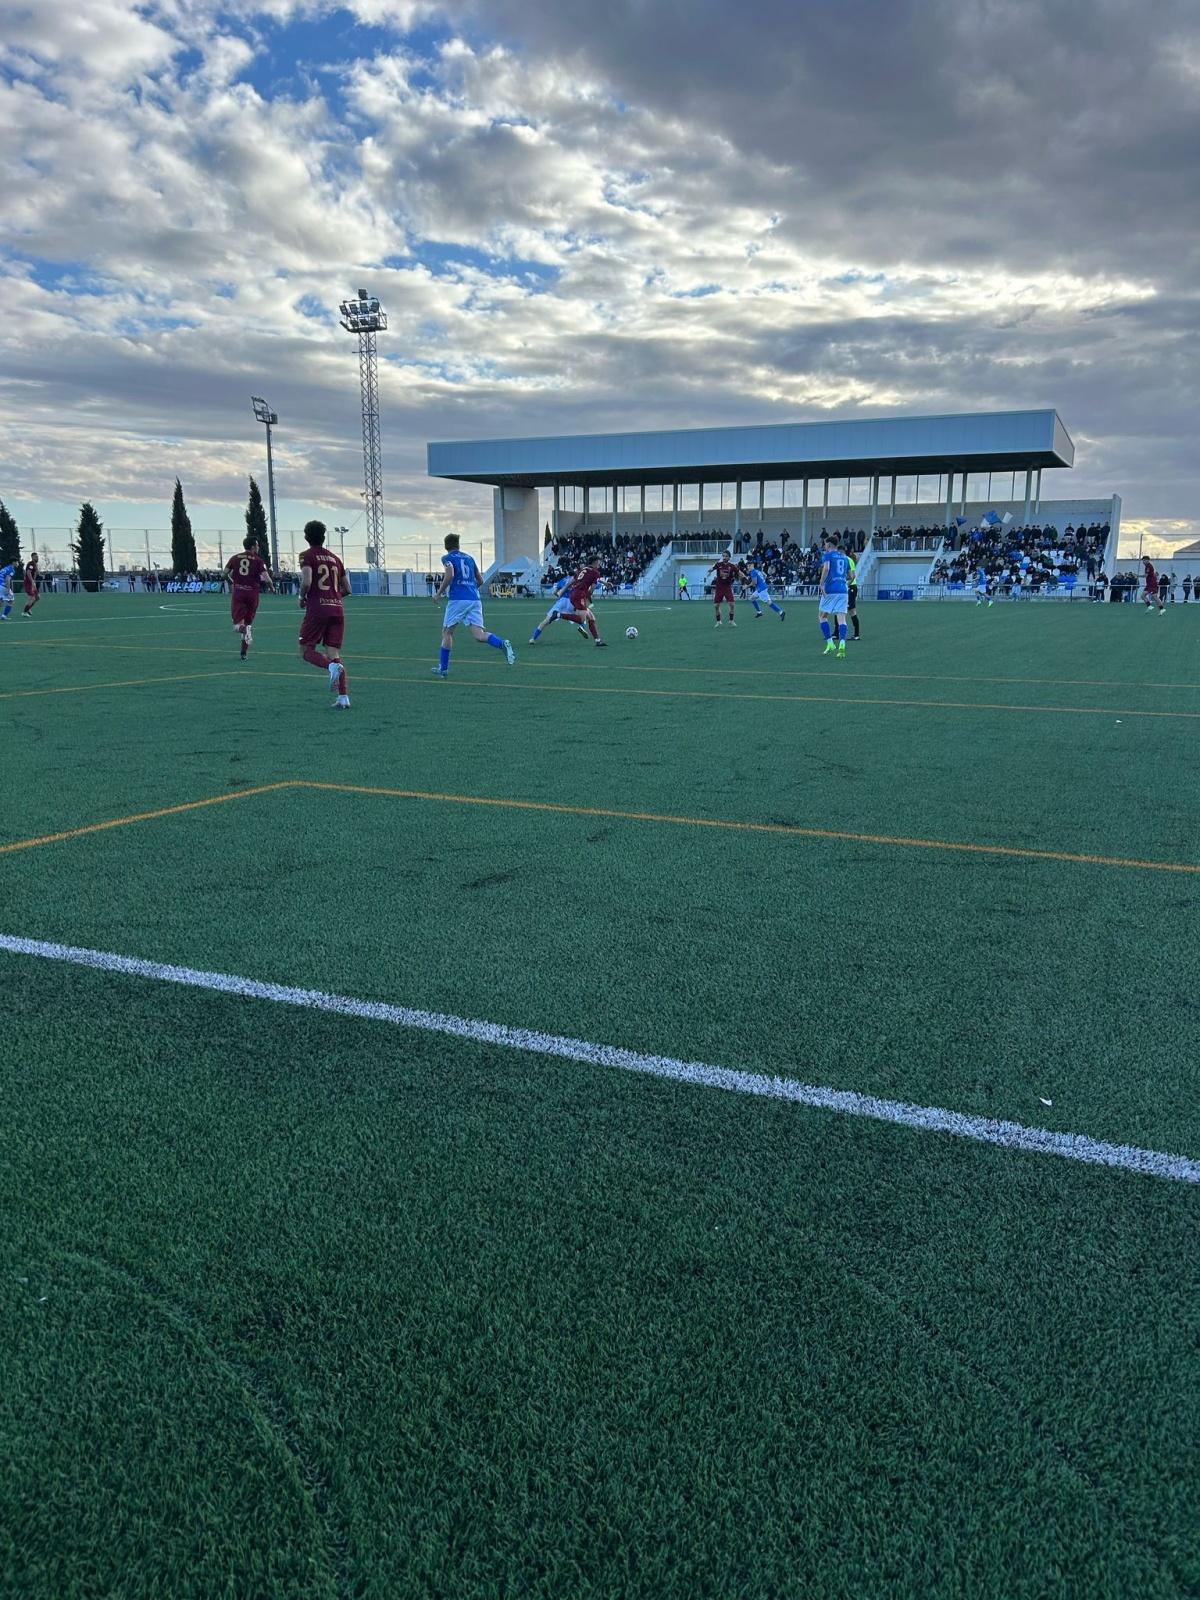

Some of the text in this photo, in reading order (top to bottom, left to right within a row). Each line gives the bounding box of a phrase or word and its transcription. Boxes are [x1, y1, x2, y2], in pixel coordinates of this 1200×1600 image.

[239, 558, 250, 576] 8
[461, 559, 470, 579] 6
[578, 569, 587, 580] 6
[837, 559, 845, 575] 8
[317, 564, 339, 593] 21
